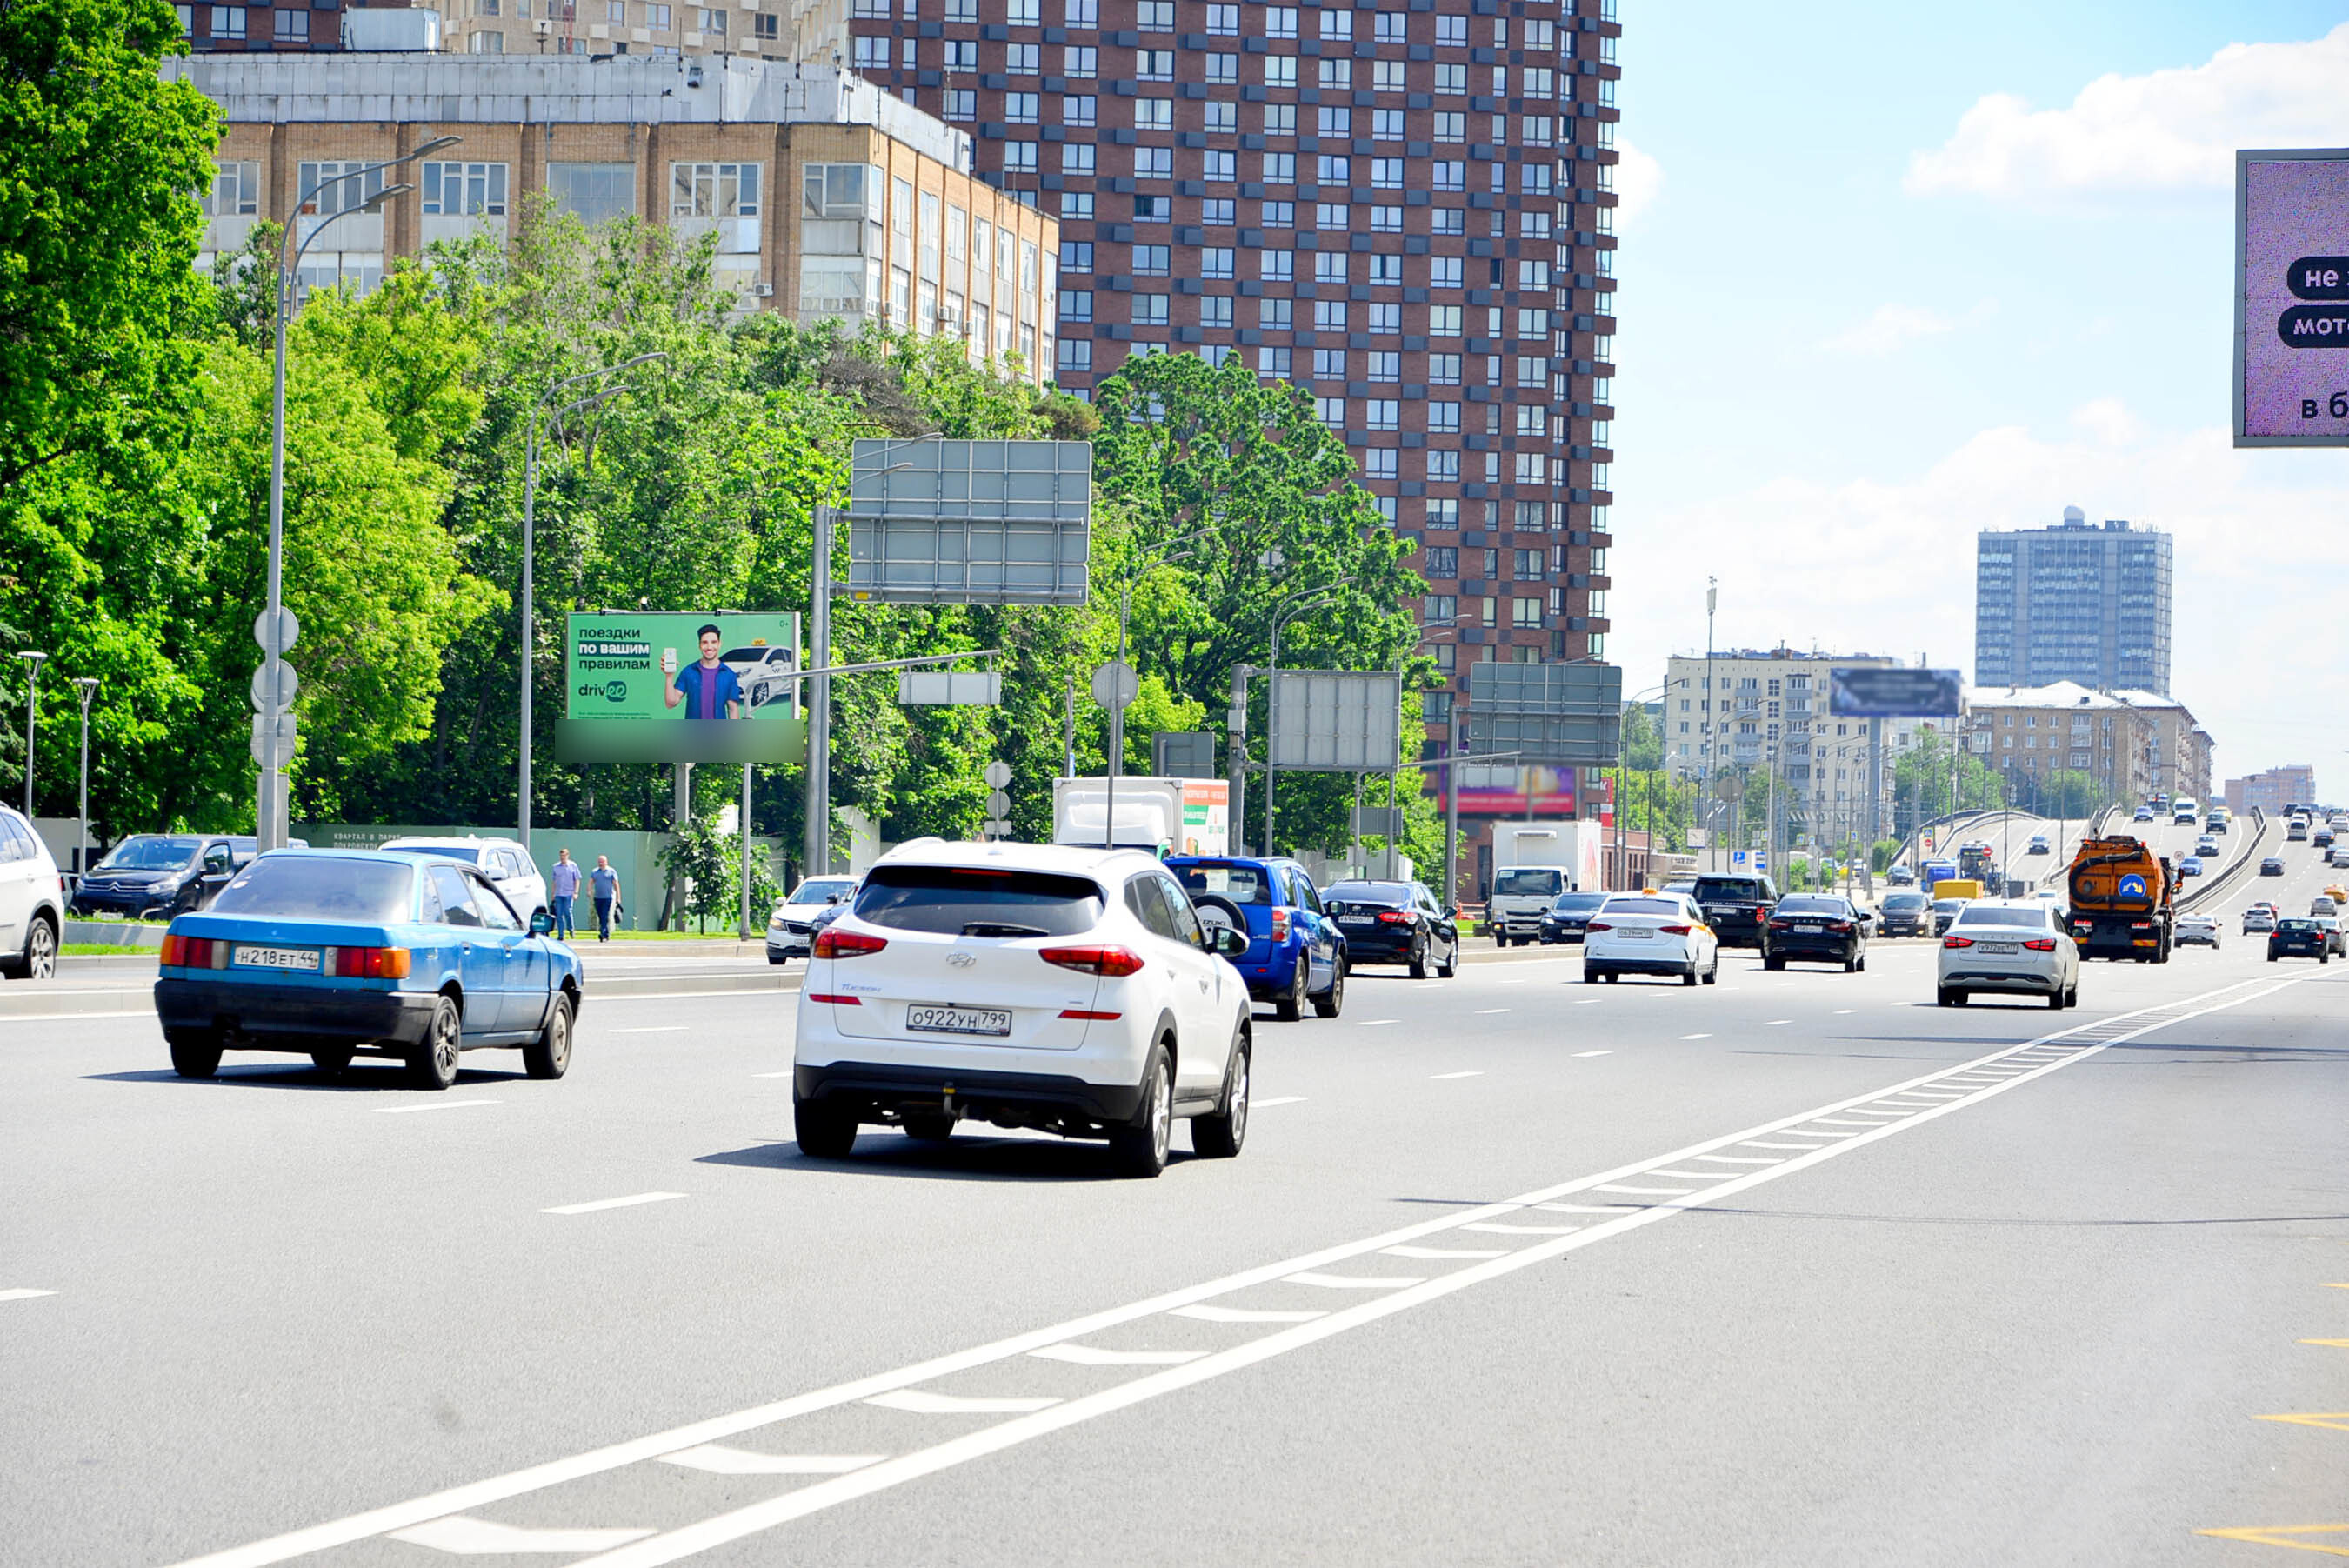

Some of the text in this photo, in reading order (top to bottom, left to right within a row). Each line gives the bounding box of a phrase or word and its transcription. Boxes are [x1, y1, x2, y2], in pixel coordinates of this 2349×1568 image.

[2306, 269, 2339, 287] не
[2293, 318, 2349, 335] мот
[2302, 399, 2319, 418] в
[579, 629, 641, 640] поездки
[579, 644, 650, 655] по вашим
[579, 659, 650, 672] правилам
